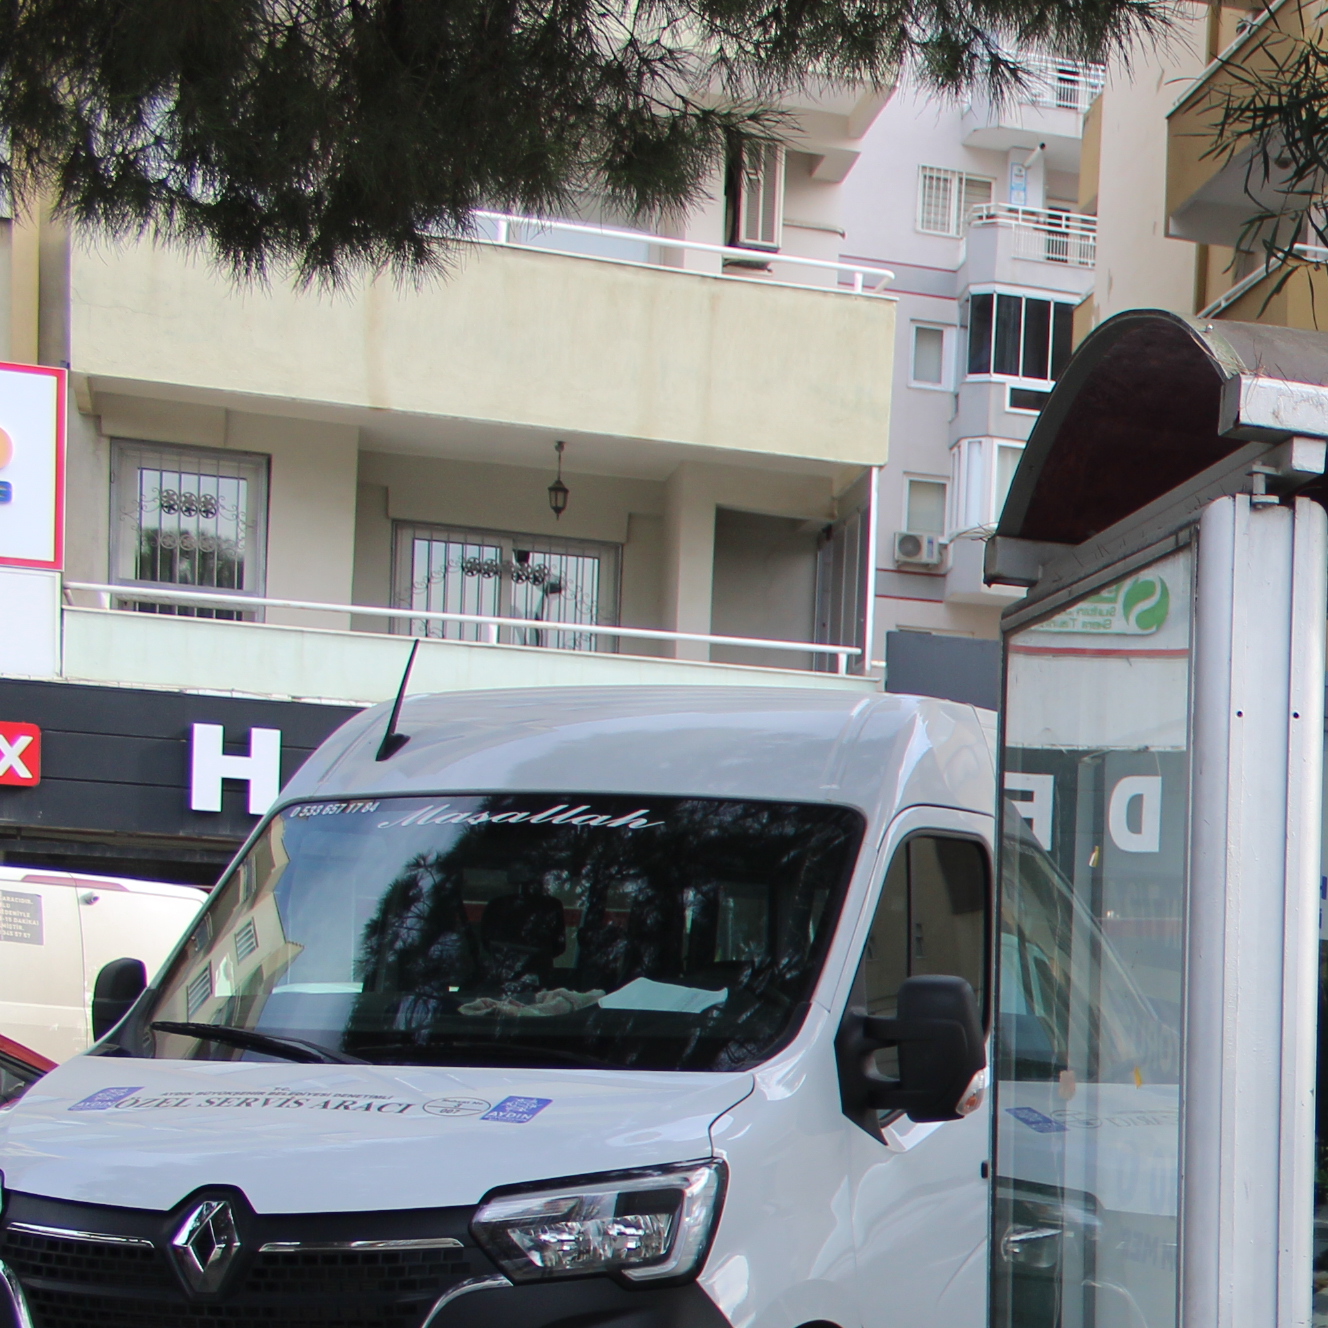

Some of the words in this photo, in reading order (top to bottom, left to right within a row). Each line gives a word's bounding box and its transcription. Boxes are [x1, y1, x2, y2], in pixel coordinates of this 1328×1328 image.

[298, 804, 322, 817] 533
[322, 803, 347, 816] 657
[346, 802, 361, 814] 17
[114, 1096, 192, 1109] ÖZEL
[196, 1095, 310, 1109] SERVİS
[308, 1099, 416, 1114] ARACI
[485, 1111, 533, 1120] AYDIN
